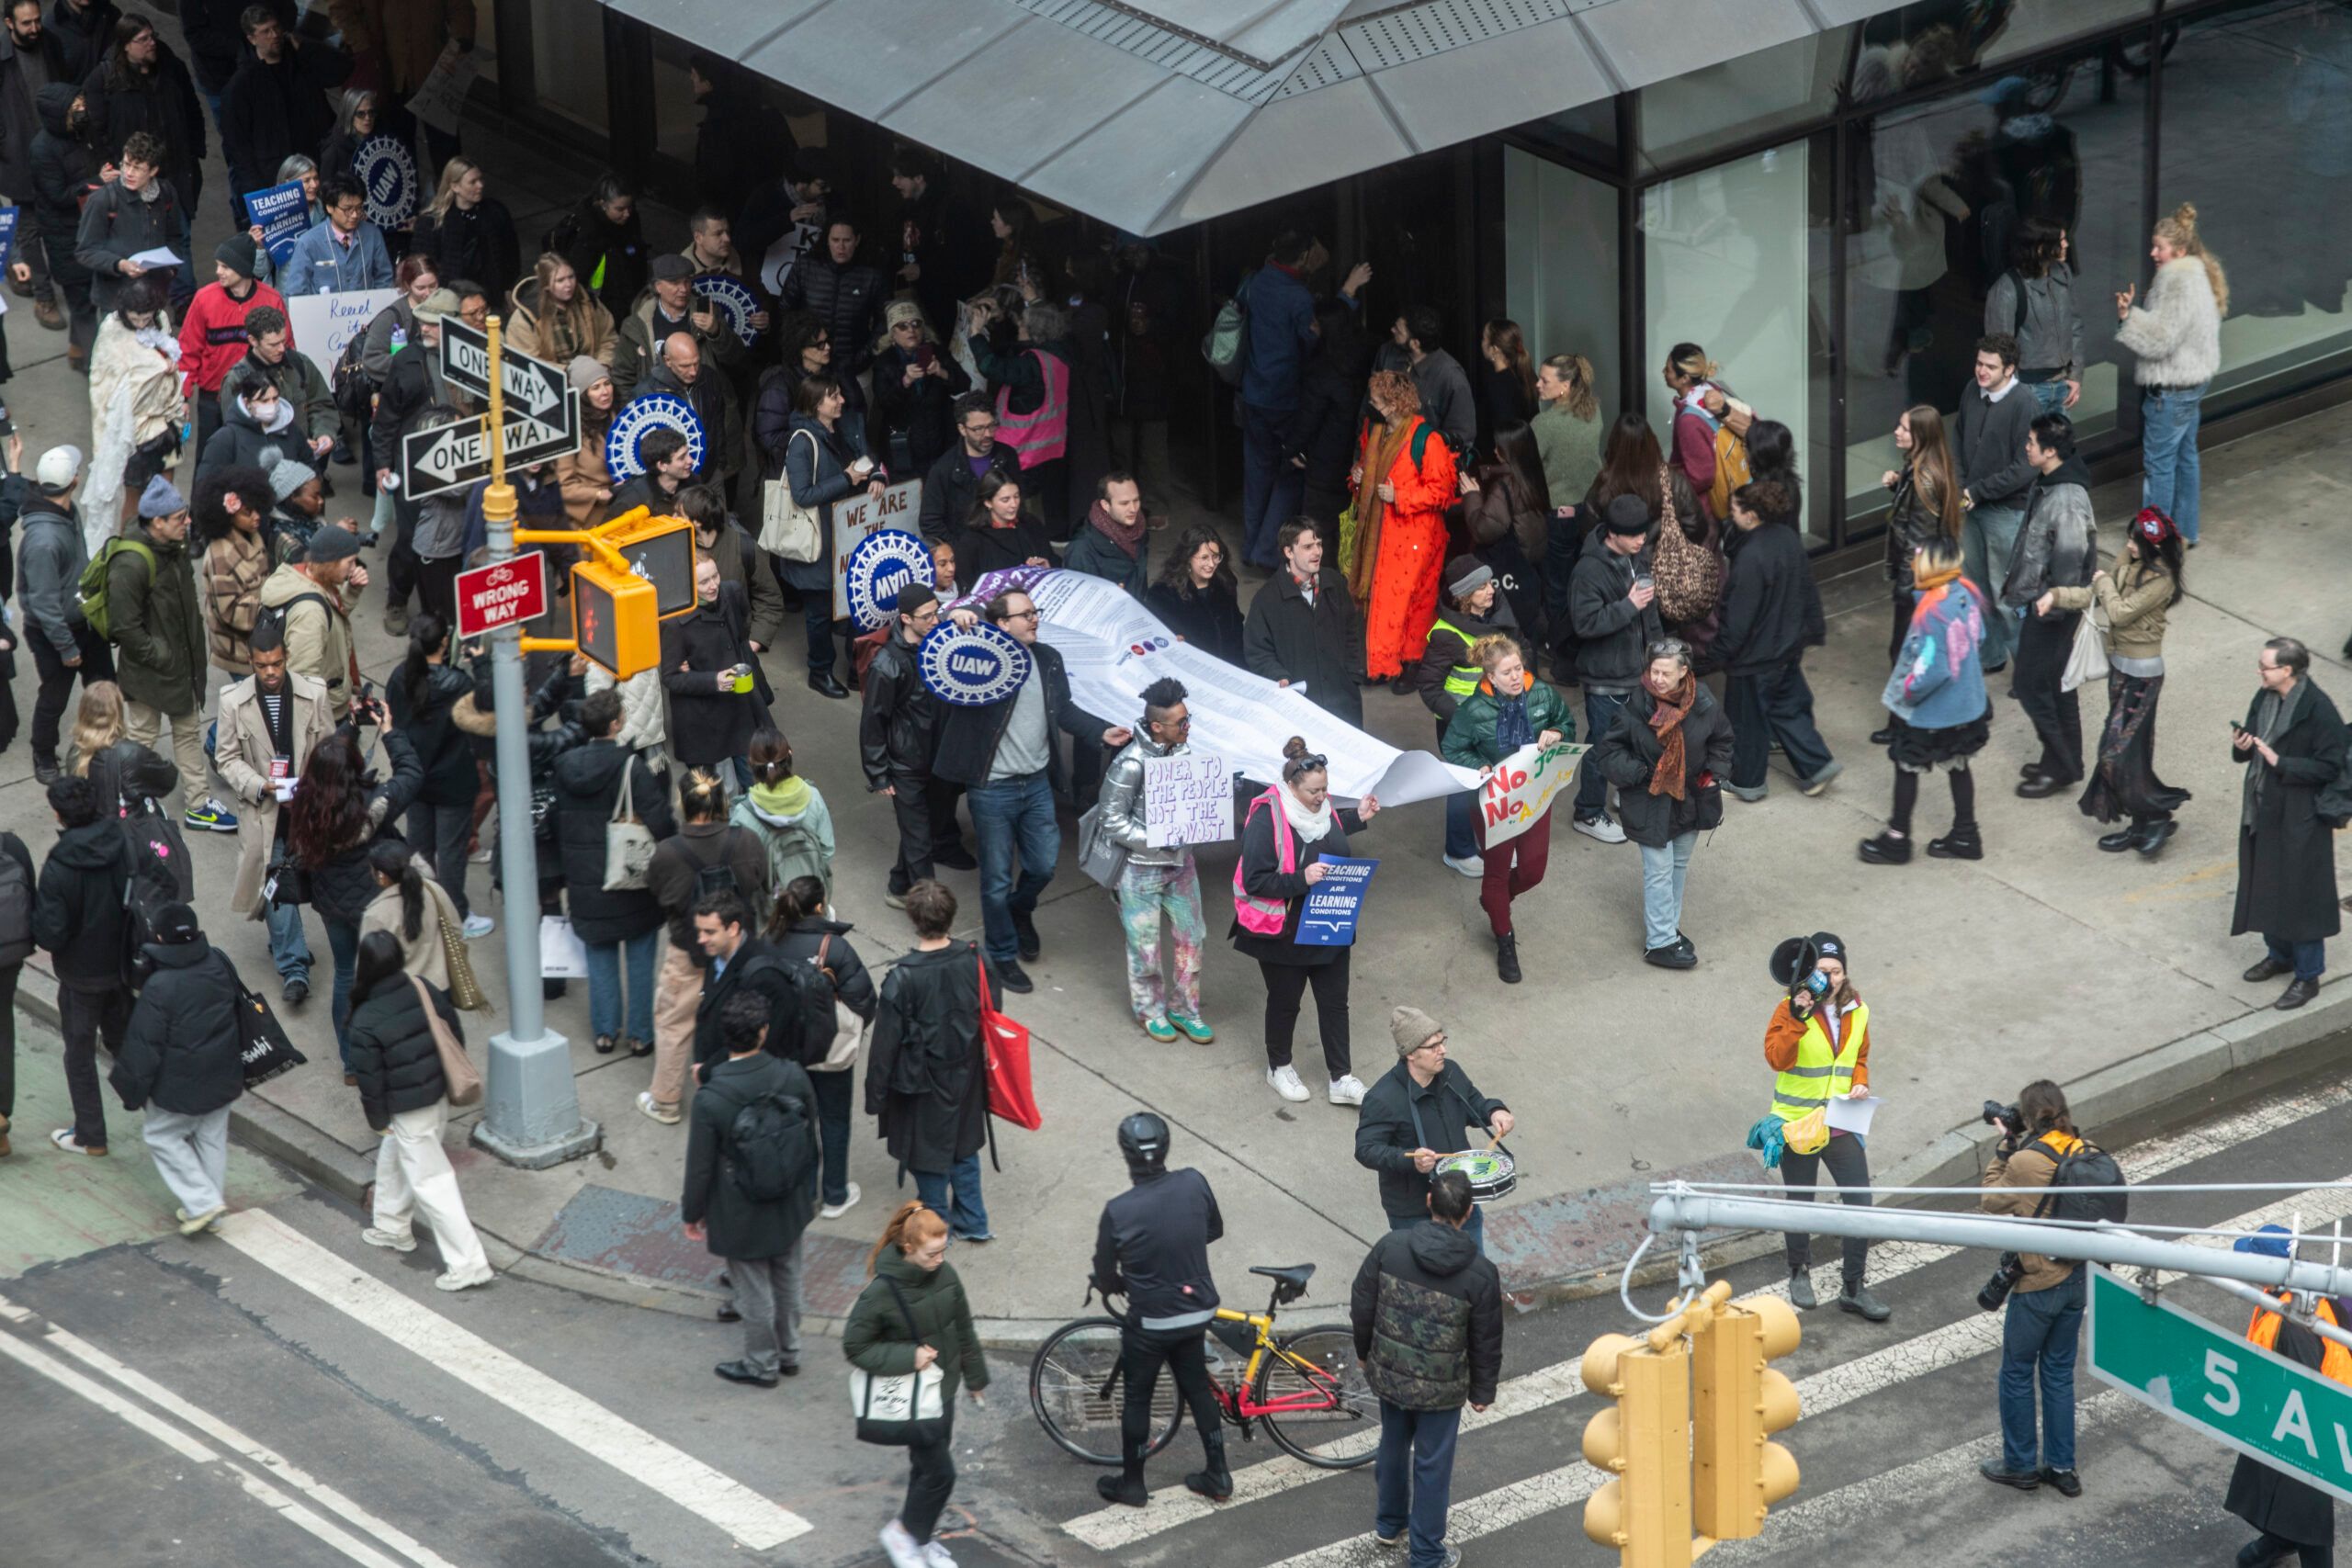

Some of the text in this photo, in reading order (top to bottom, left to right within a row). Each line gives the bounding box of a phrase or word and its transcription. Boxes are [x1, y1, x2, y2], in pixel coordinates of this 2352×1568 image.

[373, 162, 398, 202] UAW
[252, 187, 300, 210] TEACHING
[257, 199, 300, 217] CONDITIONS
[265, 212, 304, 235] EARNING
[274, 211, 288, 220] ARE
[266, 221, 303, 243] CONDITIONS
[510, 369, 546, 404] WAY
[434, 437, 481, 470] ONE
[847, 491, 908, 528] WE ARE
[472, 580, 529, 610] WRONG
[876, 569, 910, 602] UAW
[484, 600, 518, 624] WAY
[951, 654, 996, 676] UAW
[1148, 756, 1222, 785] POWER TO
[1147, 784, 1176, 805] THE
[1148, 800, 1218, 825] NOT THE
[1164, 819, 1225, 846] PROVOST
[1326, 865, 1371, 876] EACHING
[1309, 895, 1358, 908] LEARNING
[2203, 1348, 2241, 1416] 5
